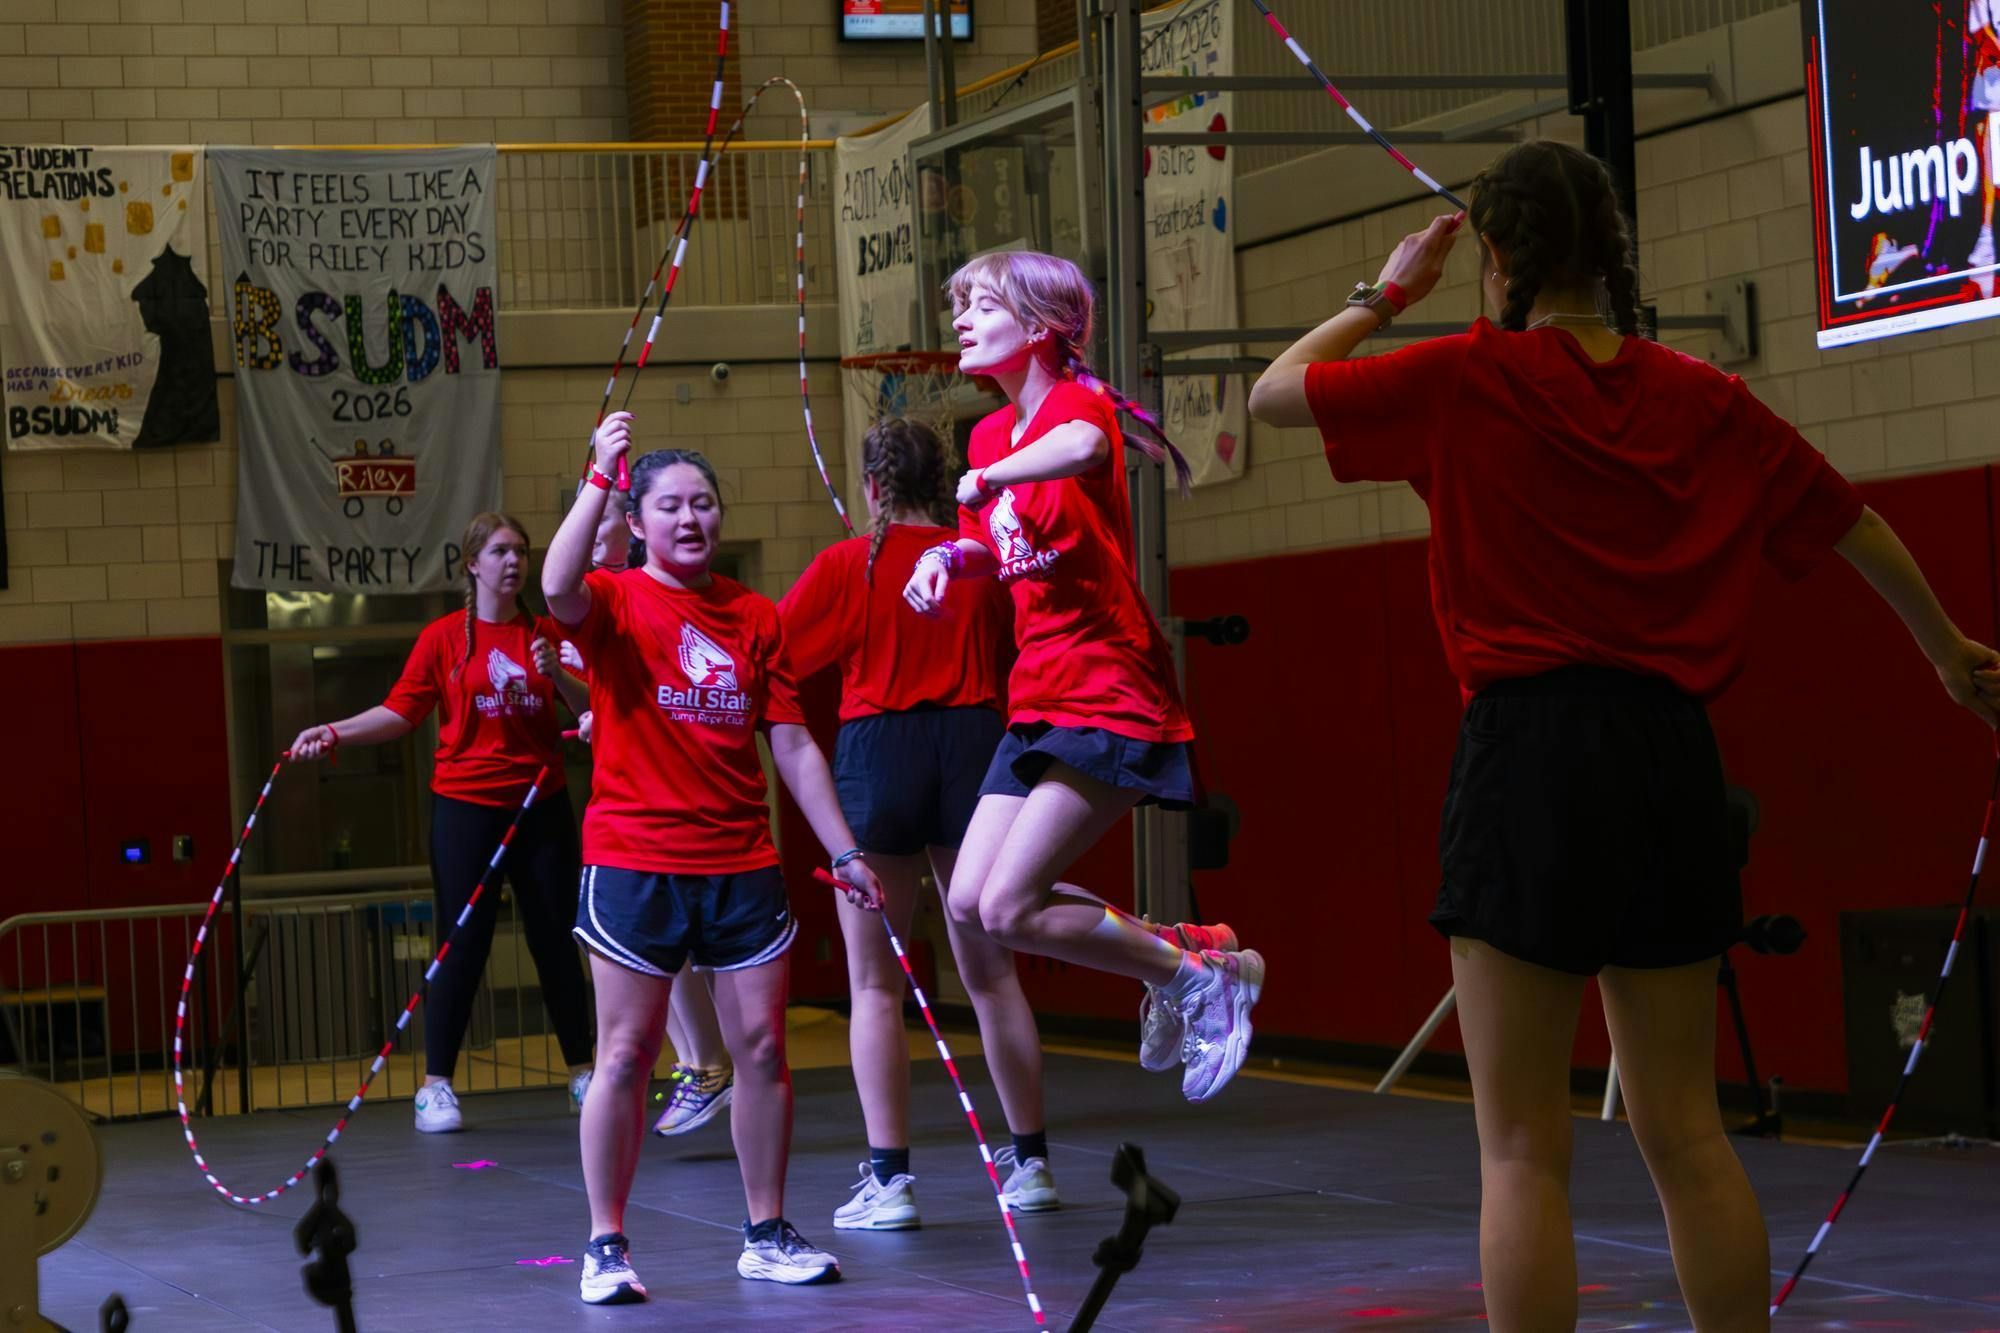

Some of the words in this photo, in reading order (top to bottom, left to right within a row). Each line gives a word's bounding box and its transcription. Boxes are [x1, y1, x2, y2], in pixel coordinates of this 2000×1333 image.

[1180, 2, 1220, 61] 2026
[0, 146, 93, 170] STUDENT
[246, 169, 284, 199] IT
[293, 172, 369, 203] FEELS
[388, 169, 454, 202] LIKE
[460, 167, 482, 196] A
[1851, 137, 1980, 220] Jump
[240, 202, 324, 237] PARTY
[340, 207, 418, 240] EVERY
[426, 202, 470, 236] DAY
[248, 238, 295, 269] FOR
[308, 243, 388, 272] RILEY
[408, 231, 486, 271] KIDS
[234, 270, 498, 385] BSUDM
[65, 357, 113, 379] EVERY
[115, 352, 144, 371] KID
[7, 380, 33, 392] HAS
[38, 380, 49, 392] A
[9, 404, 113, 439] BSUDM
[331, 386, 413, 422] 2026
[338, 463, 408, 494] Riley
[253, 541, 313, 582] THE
[327, 546, 422, 585] PARTY
[476, 692, 504, 709] Ball
[507, 692, 543, 708] State
[658, 685, 700, 708] Ball
[705, 690, 752, 710] State
[669, 711, 696, 723] Jump
